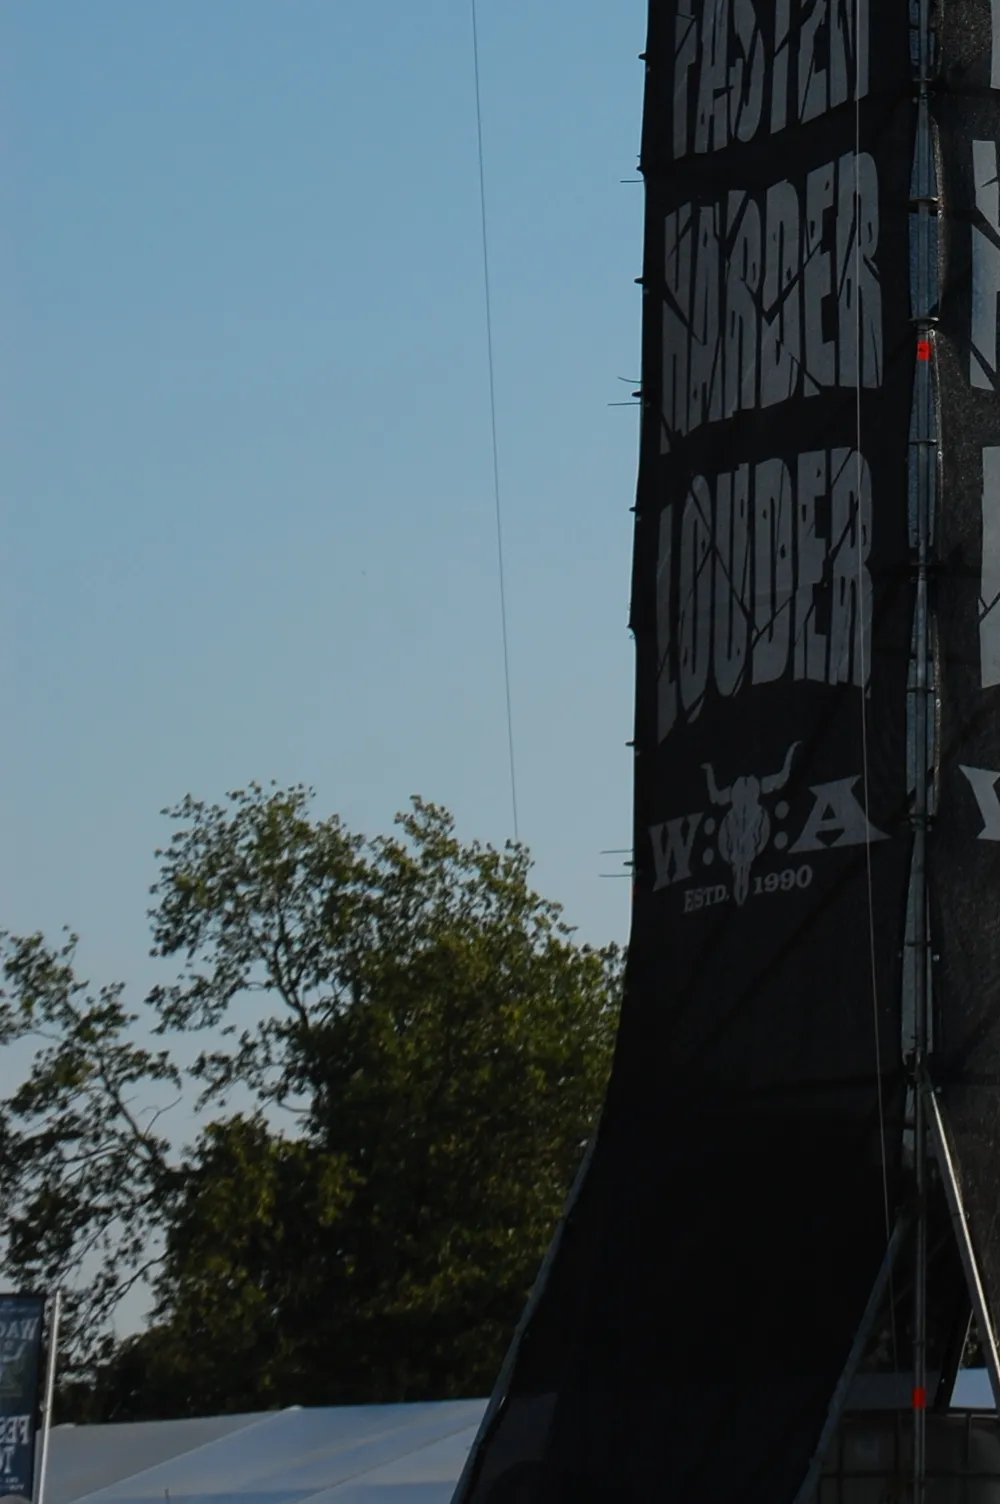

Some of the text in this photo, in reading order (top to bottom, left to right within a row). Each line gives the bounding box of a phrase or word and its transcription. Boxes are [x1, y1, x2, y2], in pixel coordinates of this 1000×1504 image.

[660, 151, 884, 454] HARDER
[656, 446, 874, 745] LOUDER
[683, 865, 813, 913] ESTD. 1990
